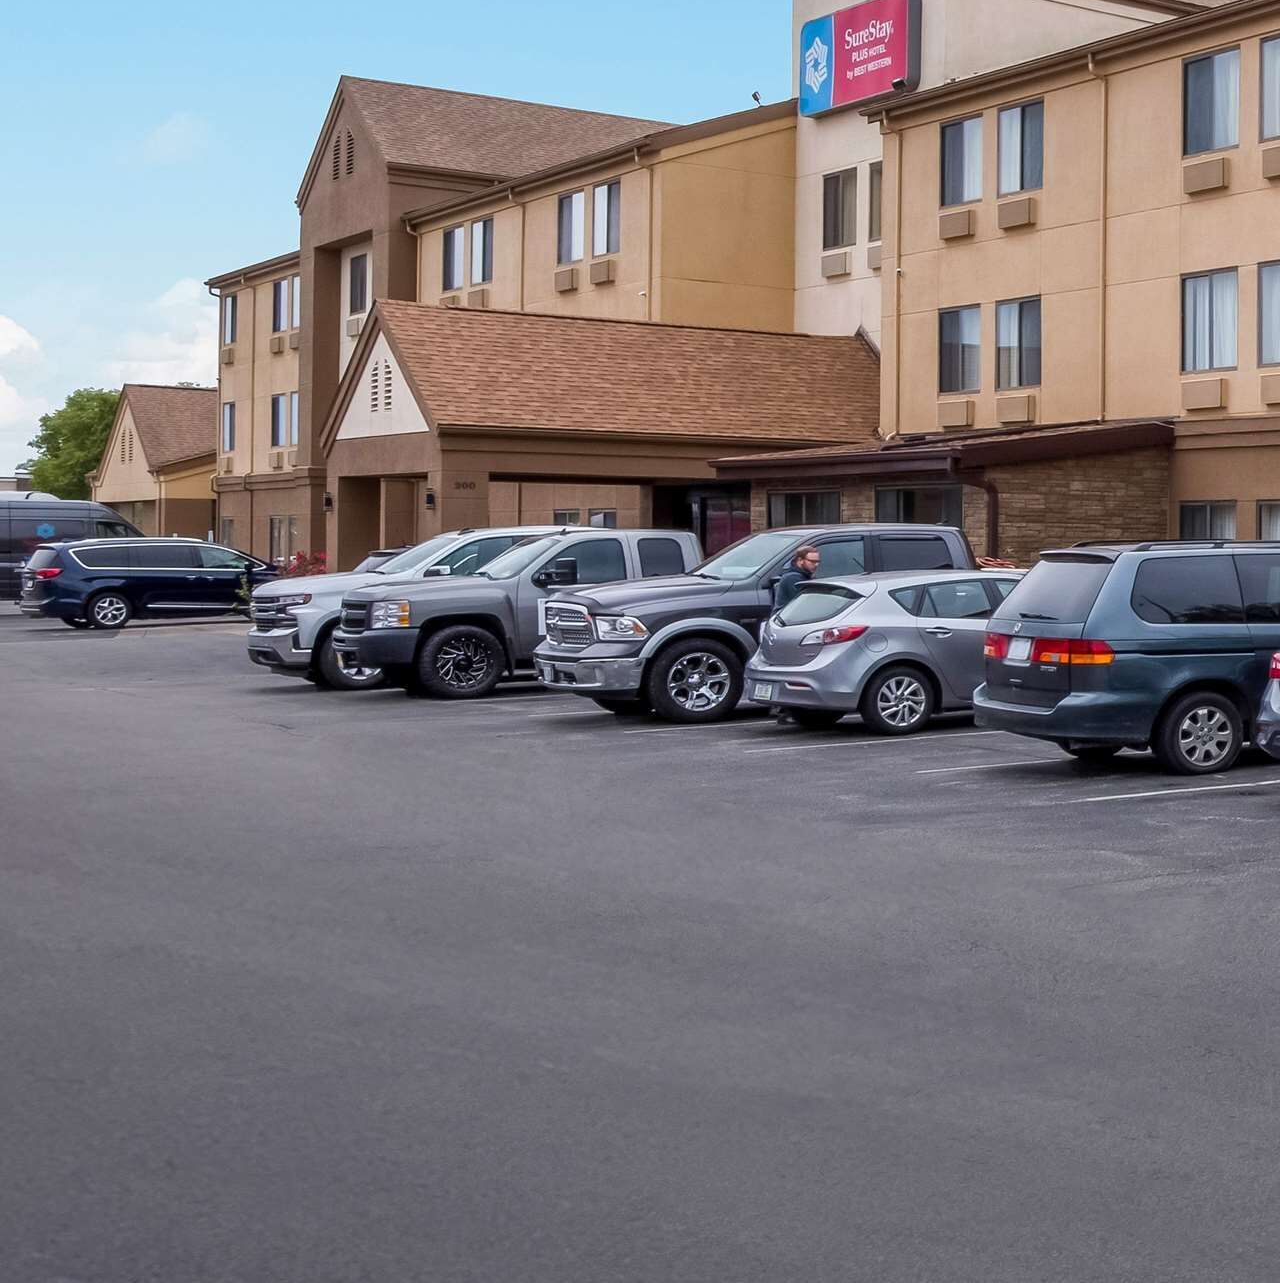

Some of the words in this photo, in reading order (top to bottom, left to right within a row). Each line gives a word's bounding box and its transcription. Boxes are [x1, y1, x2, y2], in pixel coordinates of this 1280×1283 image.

[845, 20, 893, 50] SureStay
[852, 48, 868, 63] PLUS
[869, 44, 886, 57] HOTEL
[854, 65, 866, 77] BEST
